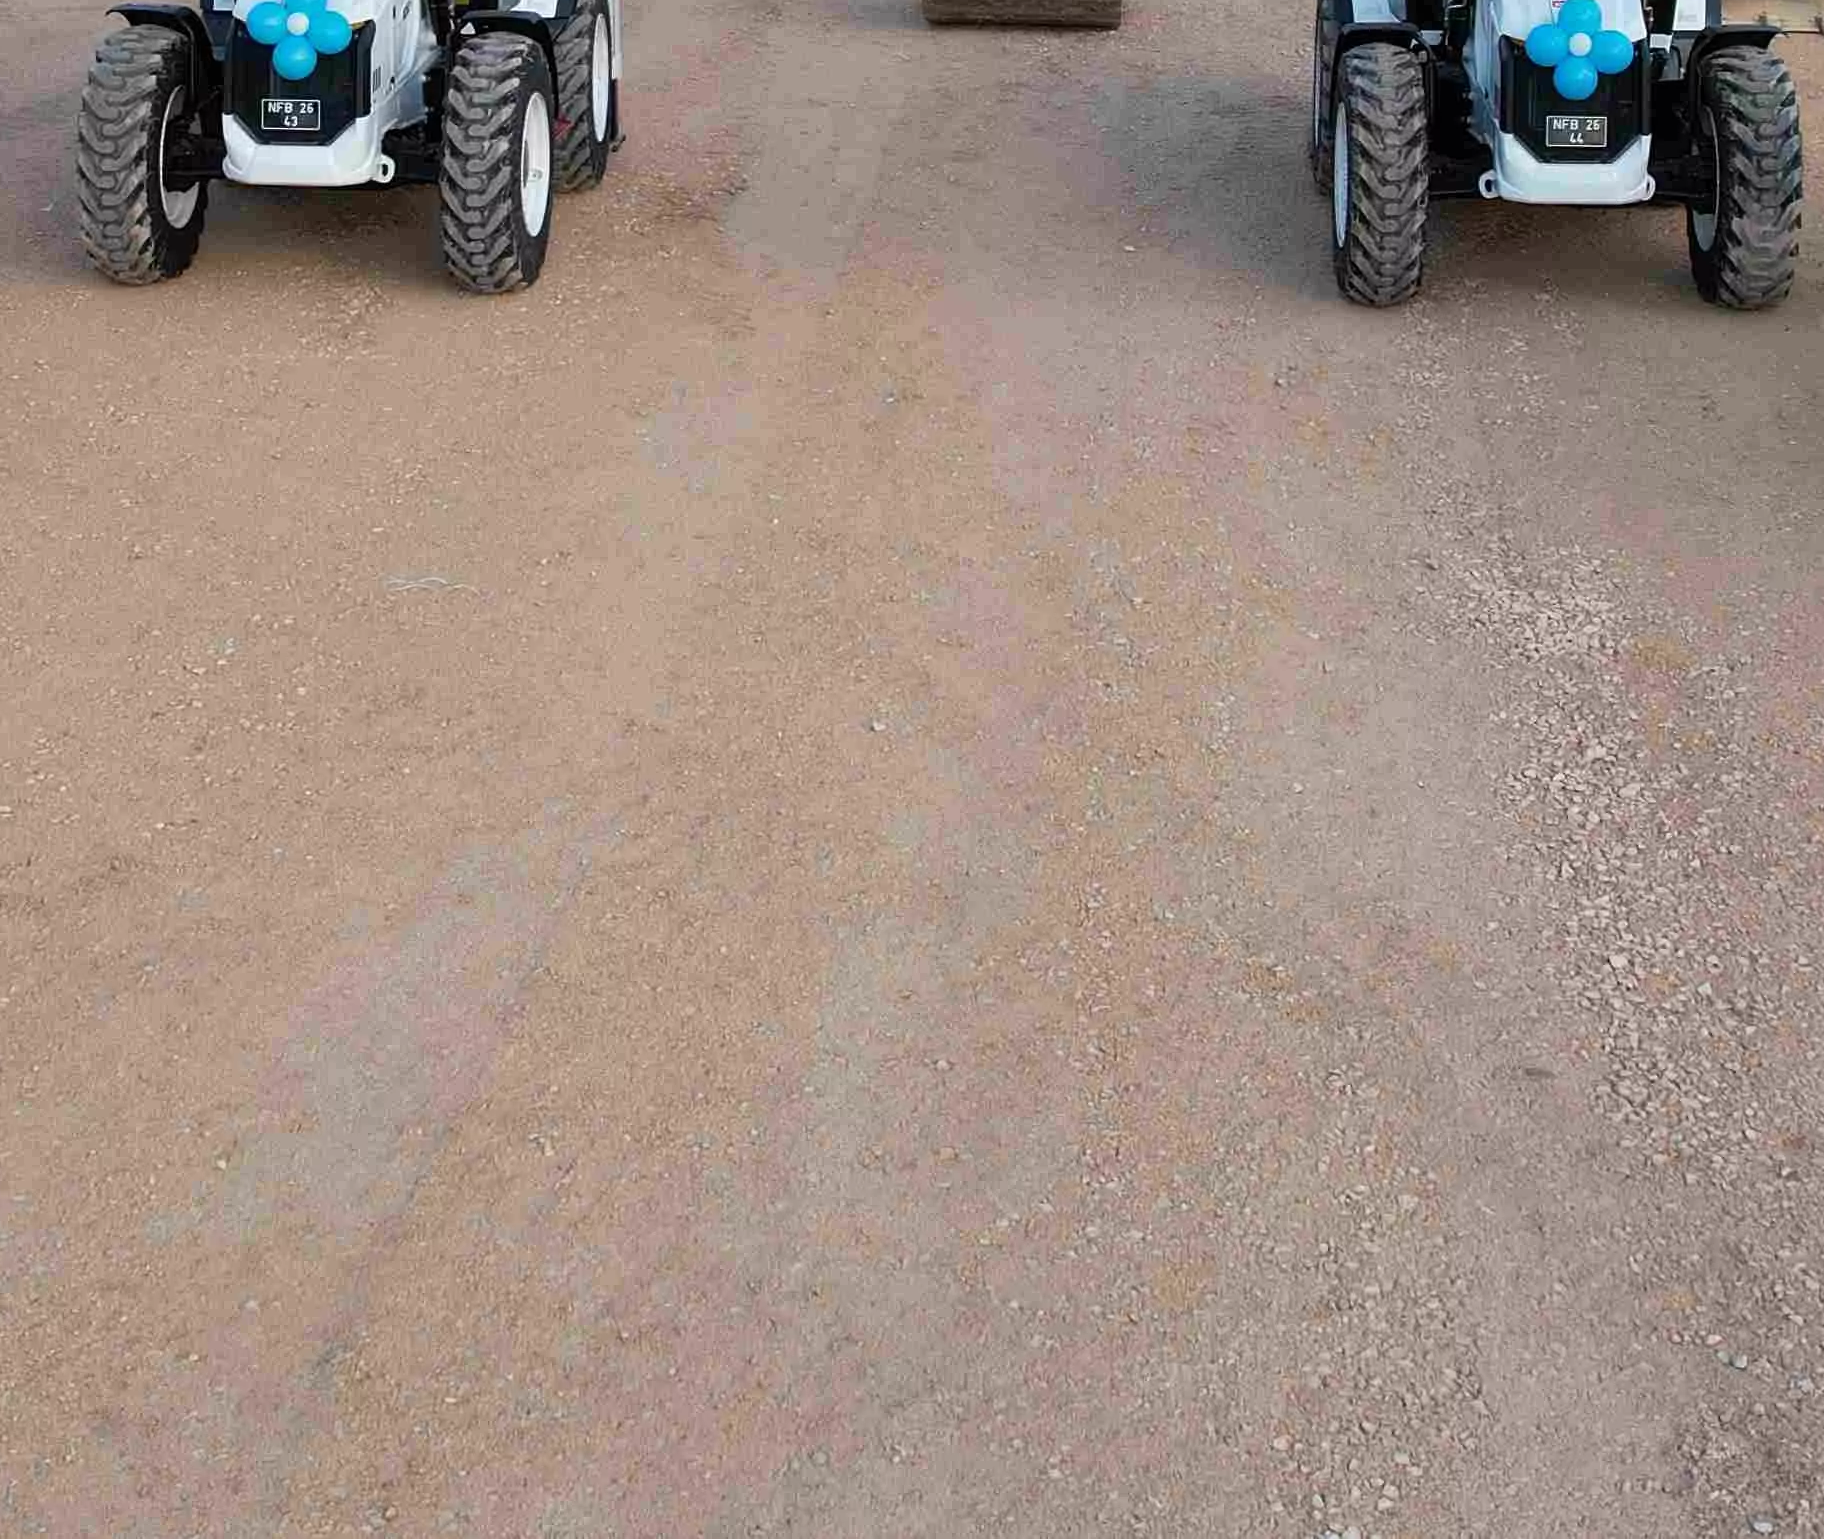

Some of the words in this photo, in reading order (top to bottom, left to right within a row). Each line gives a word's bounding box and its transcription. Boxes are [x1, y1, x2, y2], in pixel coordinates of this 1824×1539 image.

[268, 101, 294, 114] NFB
[299, 102, 315, 114] 26
[284, 115, 298, 127] 43
[1552, 118, 1579, 131] NFB
[1585, 119, 1600, 131] 26
[1569, 132, 1584, 144] 44
